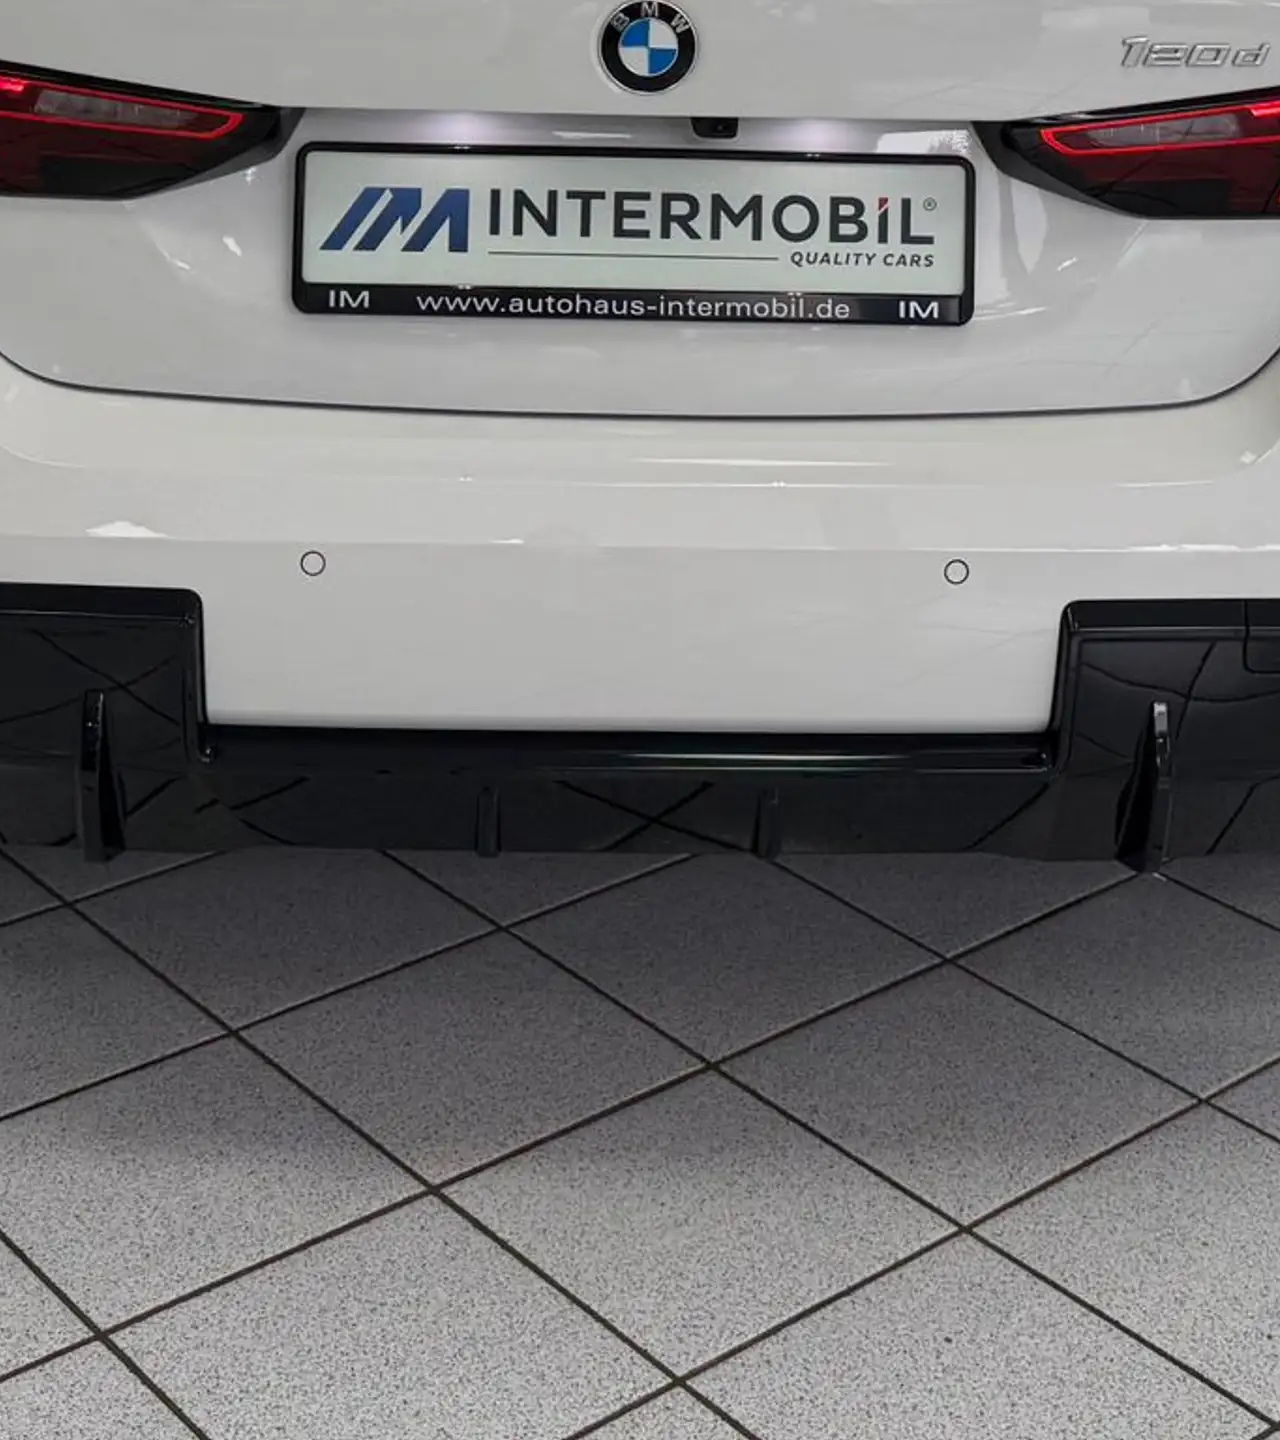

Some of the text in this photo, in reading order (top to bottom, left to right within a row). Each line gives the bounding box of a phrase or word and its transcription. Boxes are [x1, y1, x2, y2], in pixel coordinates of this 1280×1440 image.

[609, 0, 690, 33] BMW
[1121, 35, 1270, 67] 120d
[790, 250, 935, 268] QUALITY CARS
[328, 289, 940, 319] IM www.autohaus-intermobil.de IM
